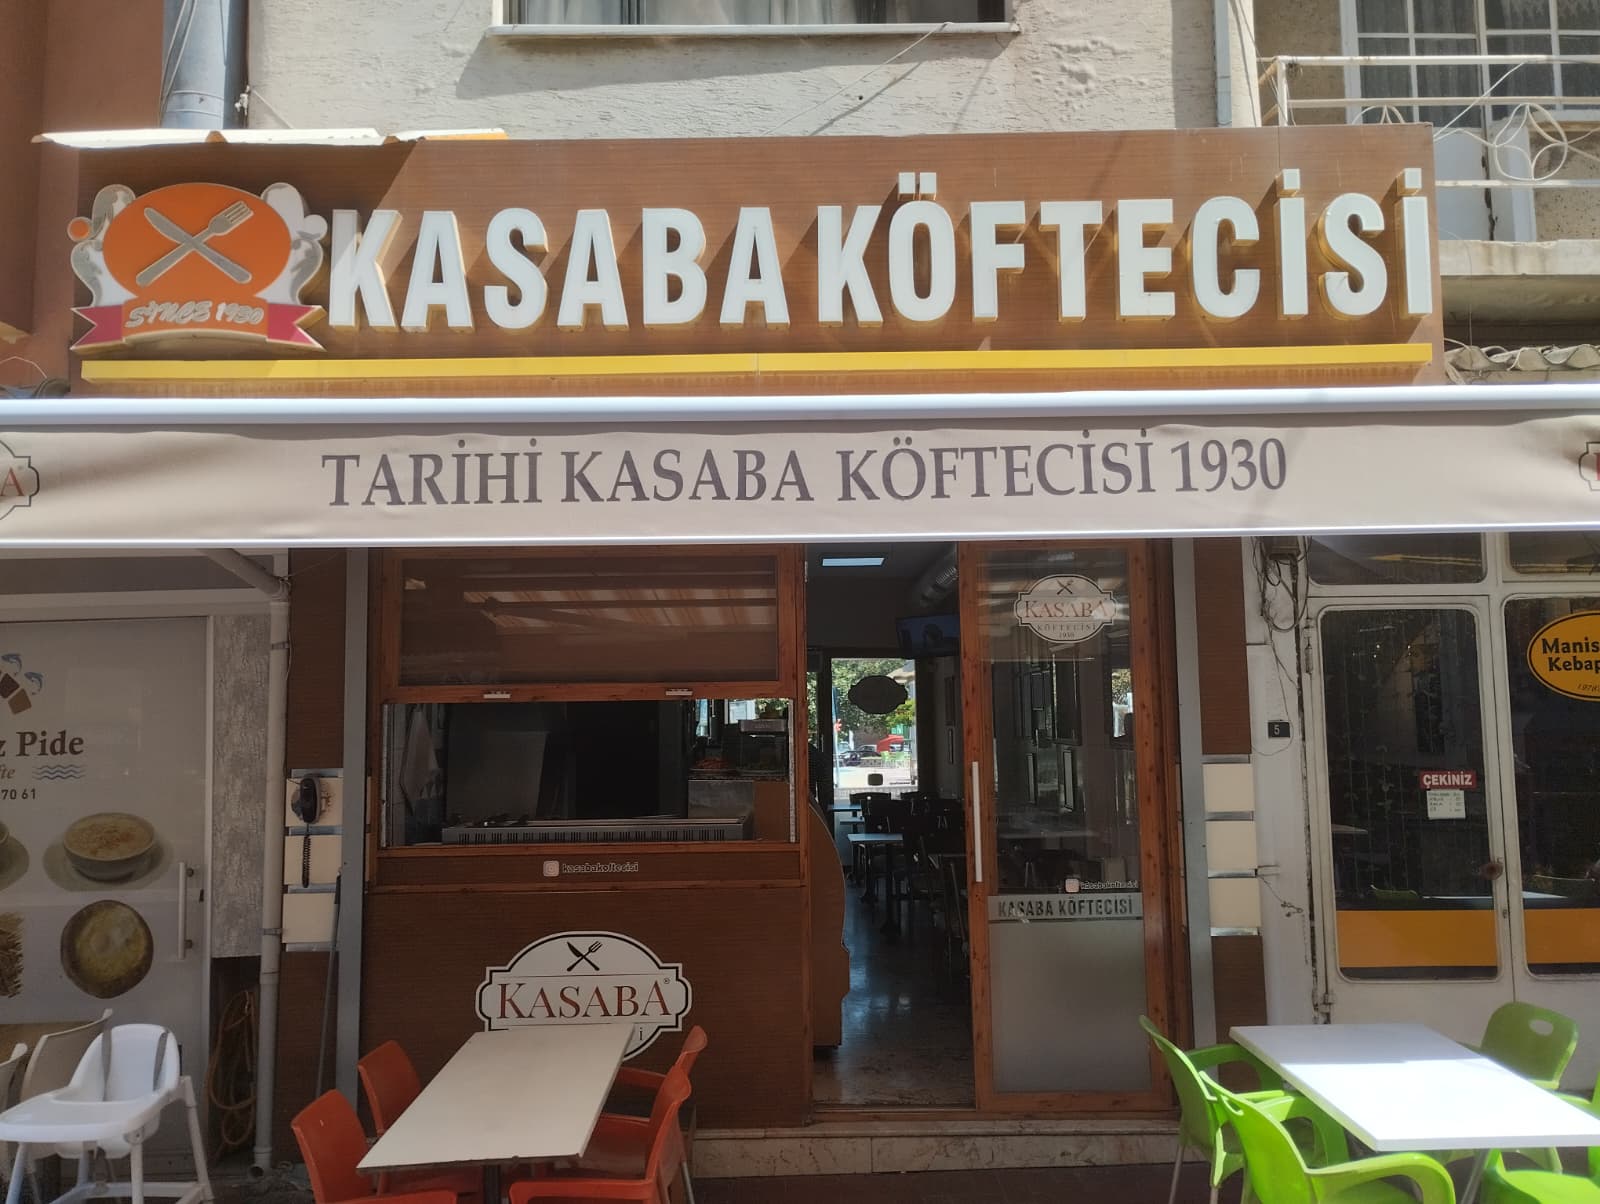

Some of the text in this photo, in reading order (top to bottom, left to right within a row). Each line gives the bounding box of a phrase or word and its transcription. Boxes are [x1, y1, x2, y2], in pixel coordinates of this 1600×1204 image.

[329, 168, 1432, 329] KASABA KÖFTECİSİ
[215, 302, 264, 325] 1930
[321, 428, 1287, 506] TARİHİ KASABA KÖFTECİSİ 1930
[1025, 600, 1111, 618] KASABA
[1273, 724, 1280, 736] 5
[16, 729, 84, 757] Pide
[1423, 771, 1473, 789] ÇEKİNİZ
[1, 788, 36, 800] 70 61
[999, 894, 1133, 918] KASABA KÖFTECİSİ
[496, 980, 672, 1019] KASABA
